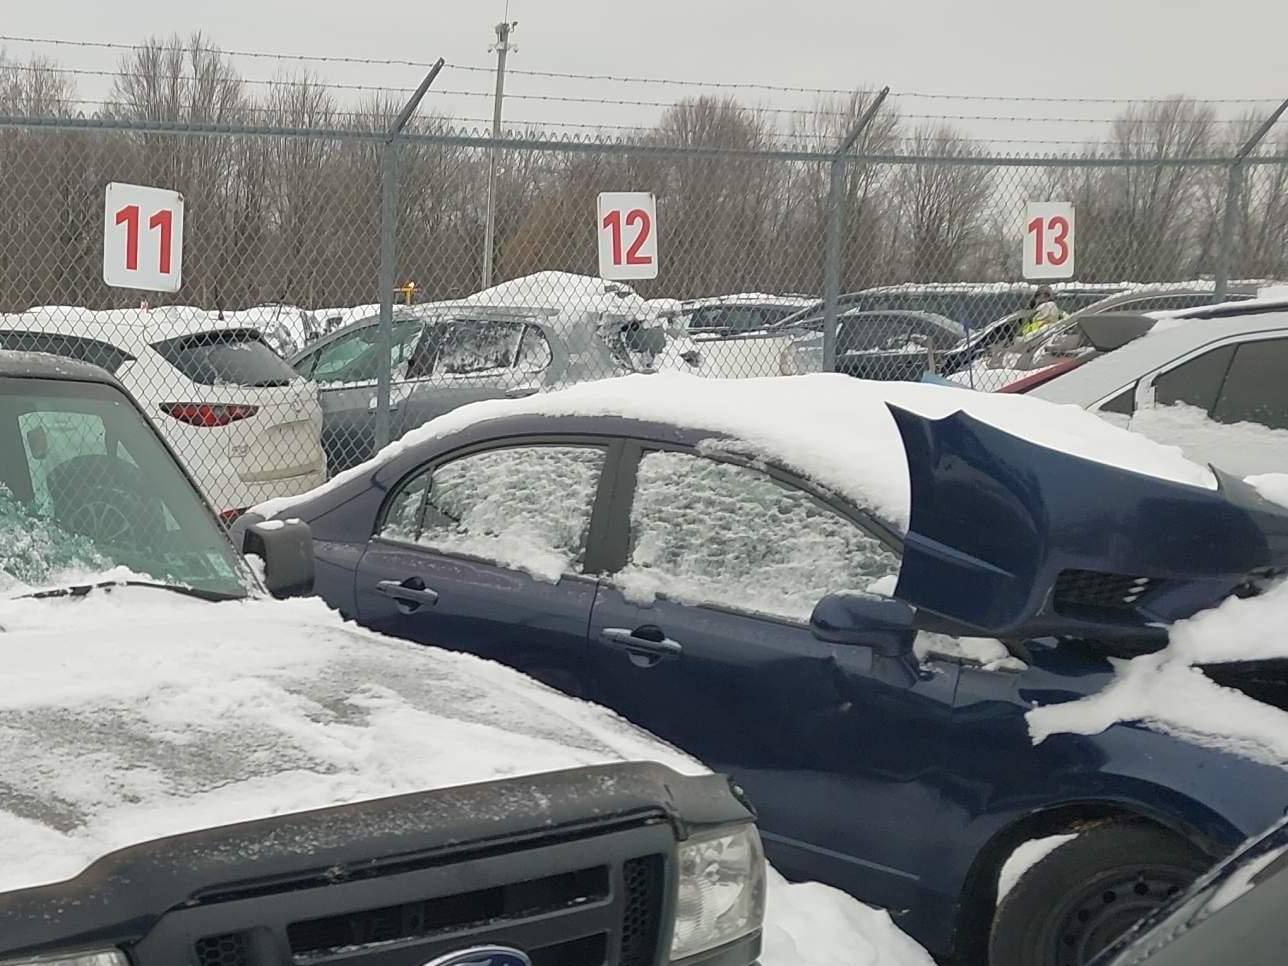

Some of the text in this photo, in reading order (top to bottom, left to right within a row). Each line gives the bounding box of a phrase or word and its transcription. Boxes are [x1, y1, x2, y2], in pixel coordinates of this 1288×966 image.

[115, 205, 173, 274] 11
[602, 209, 652, 266] 12
[1028, 216, 1069, 266] 13
